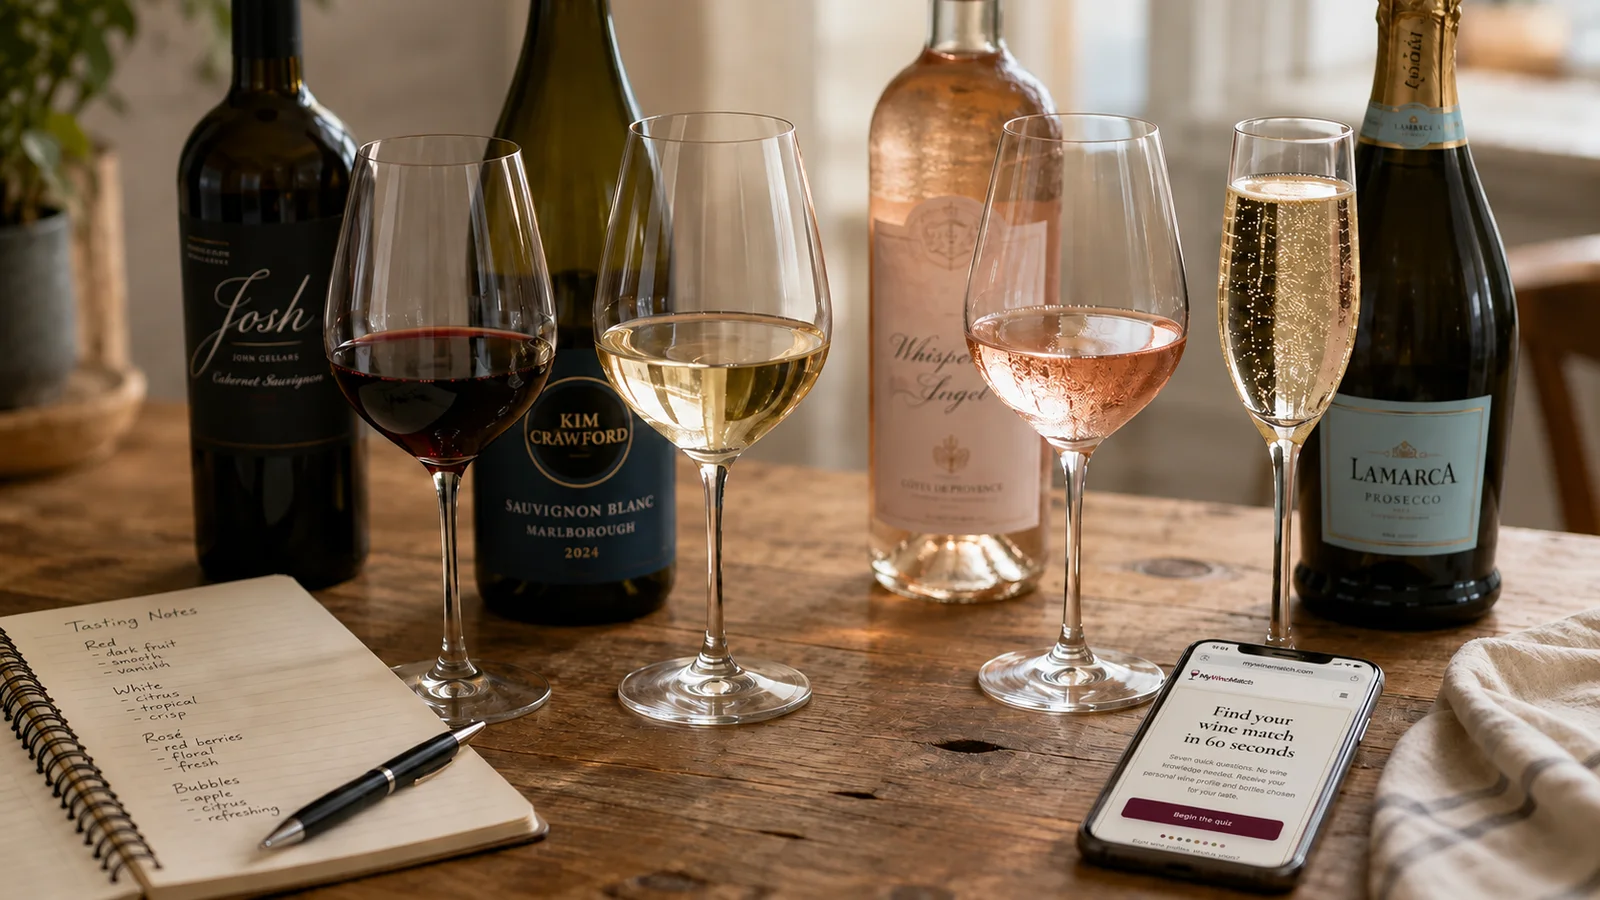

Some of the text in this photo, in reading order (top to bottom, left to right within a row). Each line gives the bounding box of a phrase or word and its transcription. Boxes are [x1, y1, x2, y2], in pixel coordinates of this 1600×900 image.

[190, 268, 315, 379] Josh
[258, 353, 300, 363] CELLARS
[889, 332, 974, 373] Whispe
[212, 371, 324, 389] Cabernet Sauvignon
[560, 413, 599, 428] KIM
[530, 427, 628, 446] CRAWFORD
[1350, 456, 1458, 486] LAMARCA
[505, 494, 655, 518] SAUVIGNON BLANC
[1365, 491, 1442, 505] PROSECCO
[526, 521, 636, 538] MARLBOROUGH
[565, 547, 599, 559] 2024
[64, 607, 198, 632] Tasting Notes
[84, 638, 117, 651] Red
[106, 640, 177, 657] dark fruit
[111, 653, 162, 666] smooth
[113, 682, 163, 695] White
[135, 691, 180, 703] citrus
[140, 696, 197, 712] tropical
[149, 711, 187, 720] crisp
[1213, 706, 1294, 726] Find your
[142, 729, 183, 743] Rosé
[1199, 721, 1294, 742] wine match
[164, 733, 243, 752] red berries
[1184, 733, 1295, 758] in 60 seconds
[172, 746, 214, 761] floral
[178, 758, 219, 772] fresh
[1169, 753, 1192, 762] Seven
[1269, 769, 1288, 777] wine
[1161, 763, 1202, 774] knowledge
[1236, 773, 1266, 784] Receive
[172, 777, 240, 794] Bubbles
[1142, 770, 1296, 798] personal wine profile and bottles chosen
[194, 790, 233, 803] apple
[1199, 789, 1217, 797] your
[202, 799, 247, 812] citrus
[208, 806, 280, 822] refreshing
[1173, 811, 1197, 821] Begin
[1199, 815, 1213, 823] the
